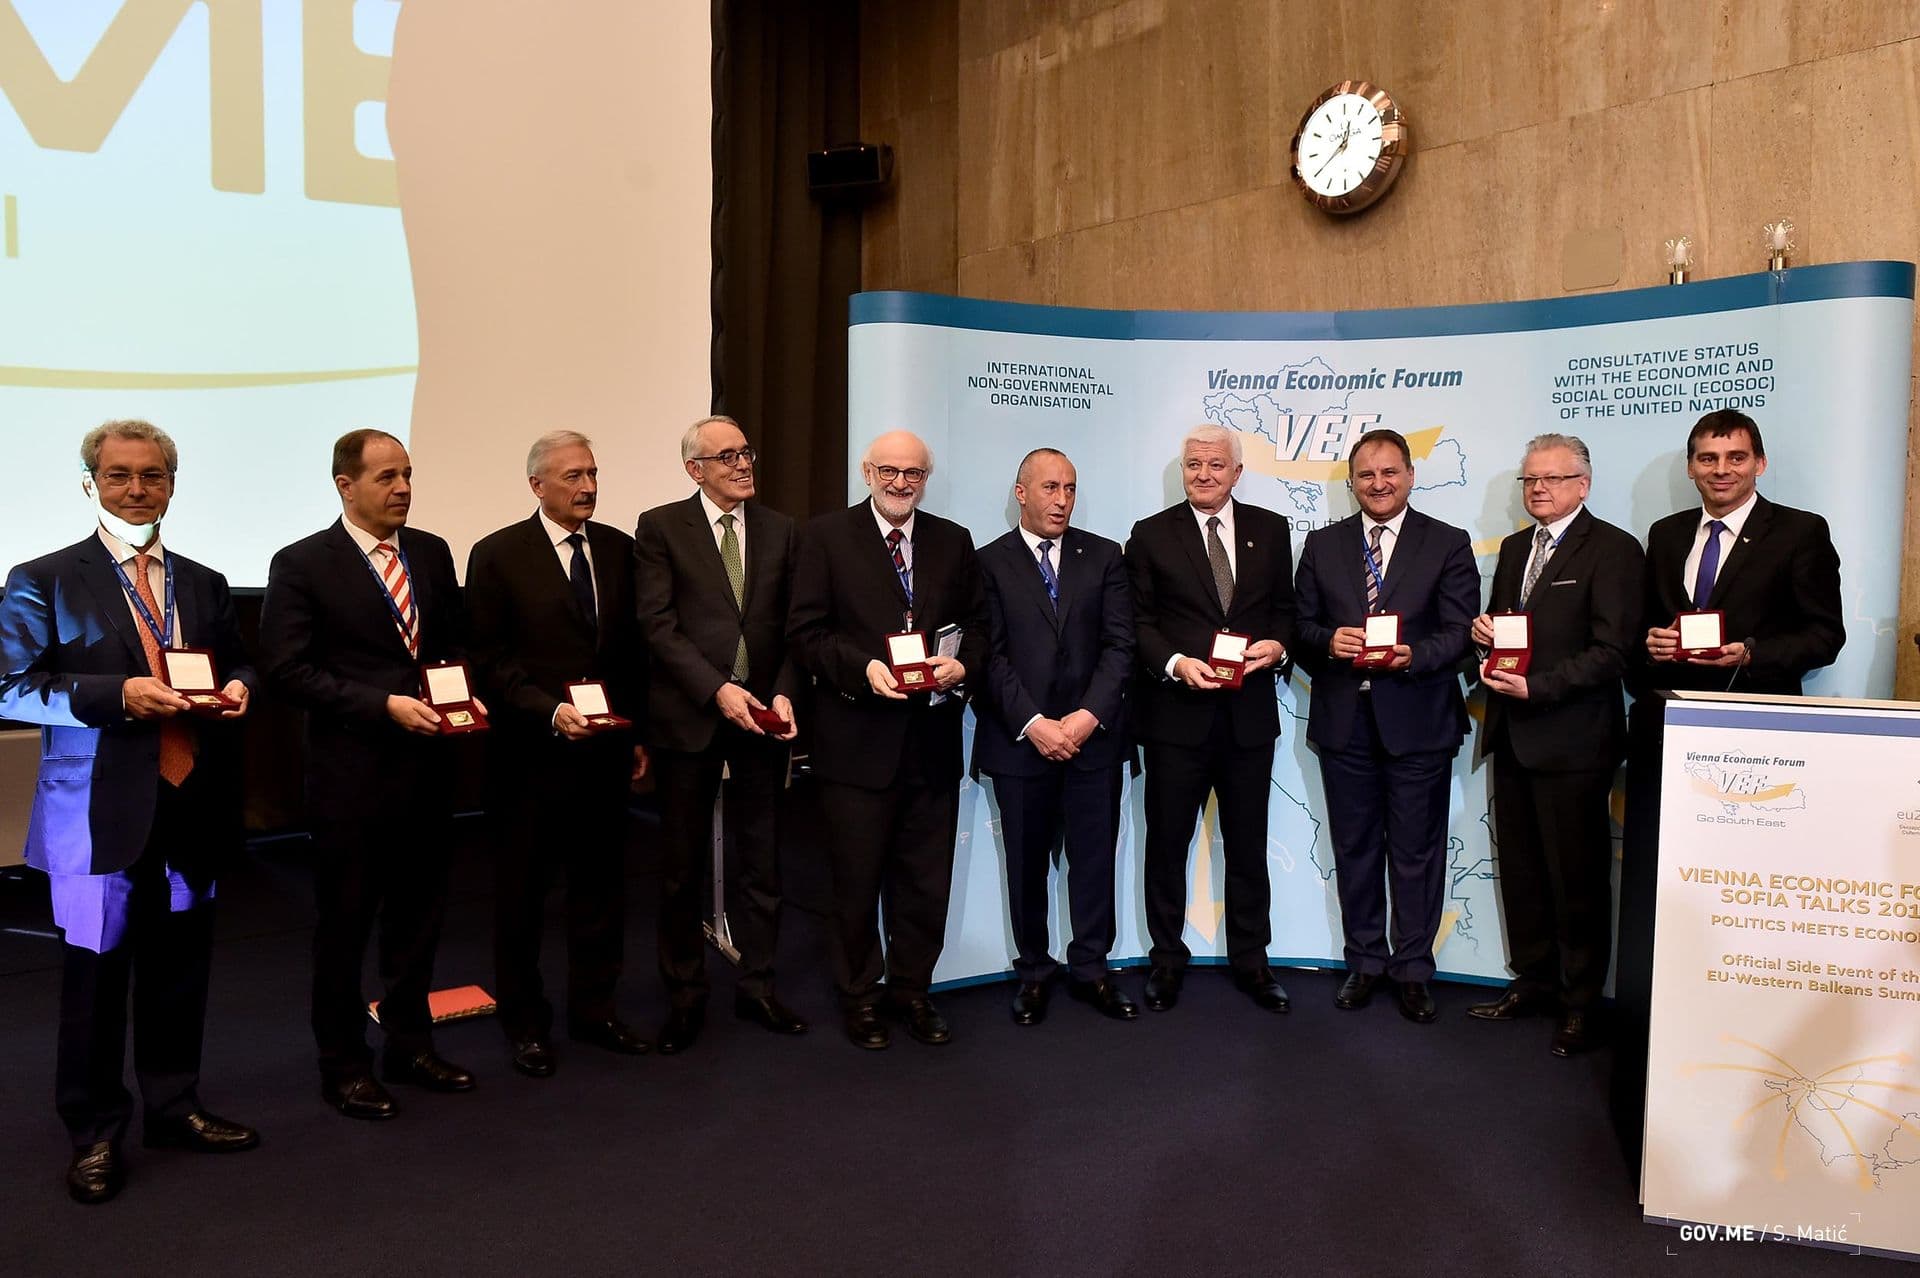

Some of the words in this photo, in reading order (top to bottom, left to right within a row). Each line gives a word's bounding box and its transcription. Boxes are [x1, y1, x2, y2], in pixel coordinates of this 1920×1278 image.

[987, 361, 1095, 379] INTERNATIONAL
[1568, 349, 1689, 371] CONSULTATIVE
[1694, 342, 1759, 361] STATUS
[968, 376, 1113, 395] NON-GOVERNMENTAL
[1207, 369, 1279, 390] Vienna
[1285, 368, 1386, 390] Economic
[1392, 368, 1463, 388] Forum
[1554, 373, 1596, 388] WITH
[1602, 371, 1632, 384] THE
[1637, 362, 1730, 382] ECONOMIC
[1735, 359, 1774, 374] AND
[990, 393, 1092, 410] ORGANISATION
[1552, 389, 1608, 404] SOCIAL
[1614, 383, 1687, 400] COUNCIL
[1693, 376, 1775, 397] (ECOSOC)
[1560, 408, 1580, 419] OF
[1585, 404, 1615, 418] THE
[1621, 400, 1682, 416] UNITED
[1689, 395, 1766, 412] NATIONS
[1686, 752, 1721, 762] Vienna
[1723, 754, 1771, 766] Economic
[1773, 757, 1806, 767] Forum
[1696, 814, 1715, 823] Go
[1716, 815, 1755, 826] South
[1756, 818, 1786, 828] East
[1678, 866, 1763, 888] VIENNA
[1769, 873, 1893, 898] ECONOMIC
[1720, 888, 1789, 908] SOFIA
[1796, 894, 1871, 915] TALKS
[1878, 900, 1920, 919] 201
[1711, 914, 1786, 931] POLITICS
[1791, 922, 1849, 937] MEETS
[1854, 926, 1920, 943] ECONO
[1722, 954, 1781, 970] Official
[1786, 959, 1821, 974] Side
[1827, 964, 1873, 979] Event
[1878, 968, 1897, 981] of
[1707, 969, 1803, 990] EU-Western
[1808, 980, 1873, 997] Balkans
[1878, 986, 1920, 1002] Sum
